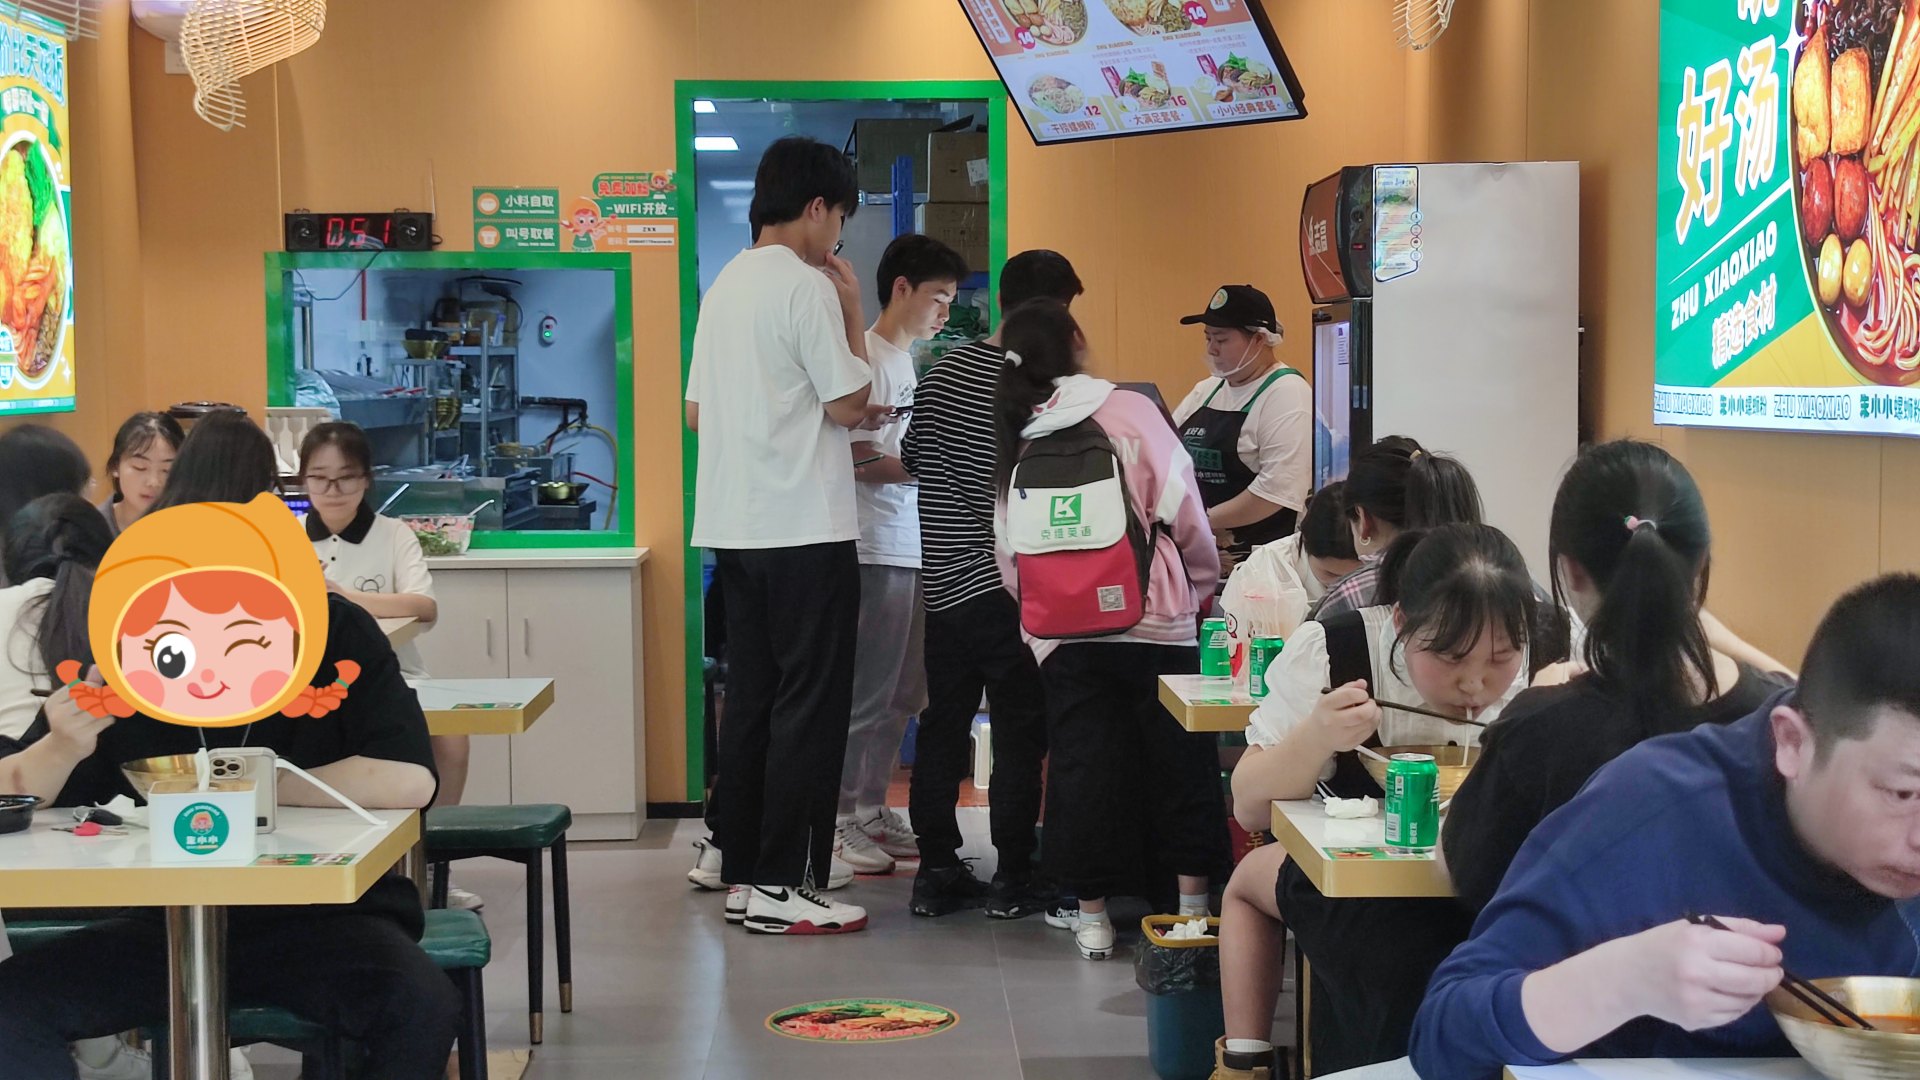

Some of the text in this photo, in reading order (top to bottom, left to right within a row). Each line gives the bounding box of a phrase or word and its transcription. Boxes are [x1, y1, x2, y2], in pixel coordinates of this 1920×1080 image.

[1189, 7, 1207, 20] 14
[1018, 31, 1035, 45] 14
[1262, 85, 1277, 97] 17
[1171, 95, 1187, 107] 16
[1217, 100, 1278, 118] 小小经典套餐
[1085, 105, 1101, 117] 12
[1133, 110, 1182, 126] 大满足套餐
[1676, 34, 1780, 246] 好汤
[505, 194, 554, 208] 小料自取
[325, 217, 392, 247] 051
[505, 227, 554, 240] 叫号取餐
[1671, 221, 1777, 331] ZHU XIAOXIAO
[1712, 272, 1777, 370] 精选食材
[1673, 392, 1712, 416] XIAOXIAO
[1774, 394, 1852, 420] ZHU XIAOXIAO
[1041, 525, 1092, 541] 克维英语
